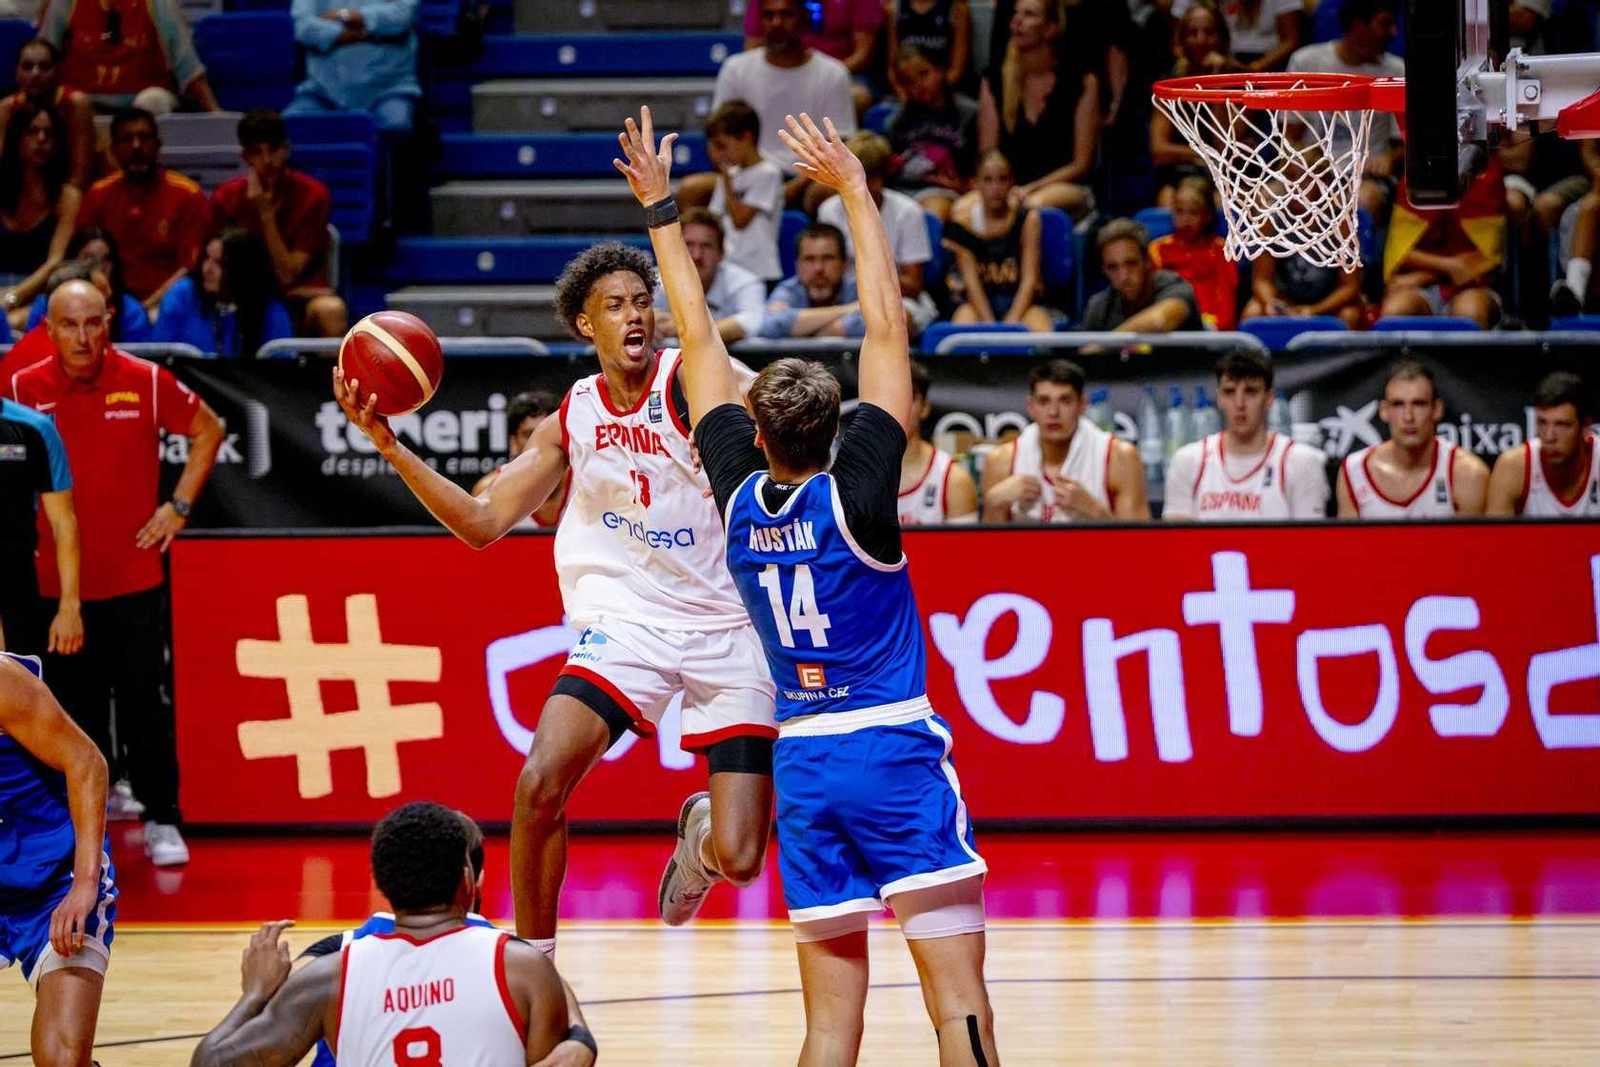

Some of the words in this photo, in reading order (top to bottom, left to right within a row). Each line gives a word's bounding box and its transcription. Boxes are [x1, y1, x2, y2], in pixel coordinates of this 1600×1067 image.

[602, 511, 695, 549] endesa
[758, 563, 831, 648] 14
[383, 977, 455, 1014] AQUINO
[393, 1026, 443, 1067] 8
